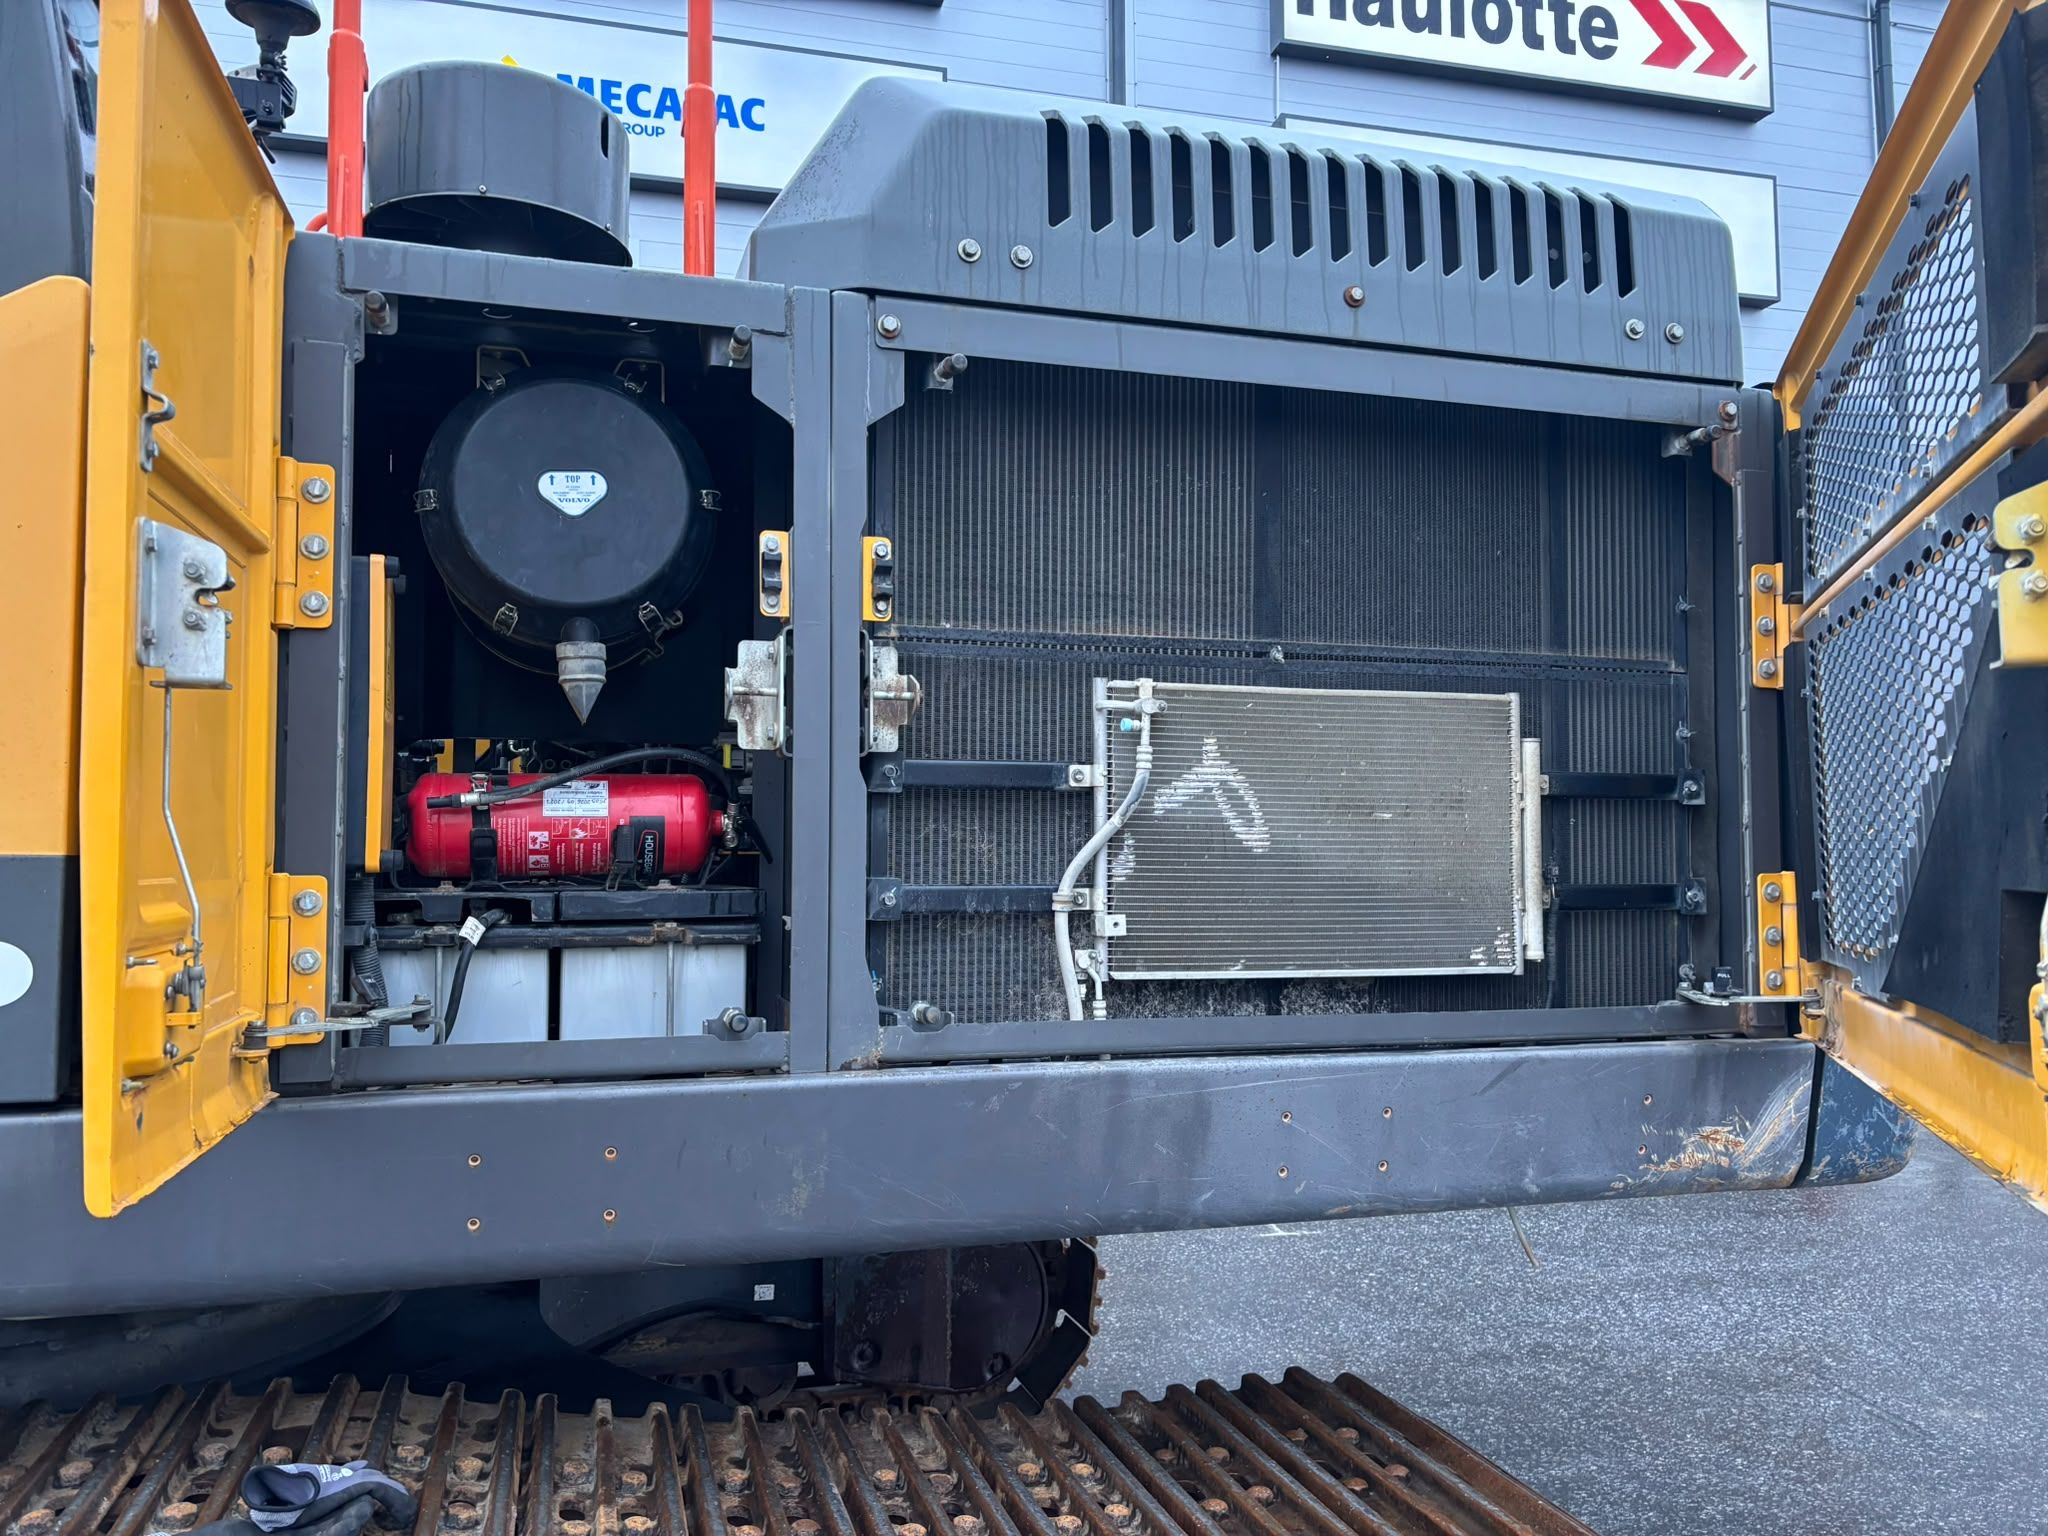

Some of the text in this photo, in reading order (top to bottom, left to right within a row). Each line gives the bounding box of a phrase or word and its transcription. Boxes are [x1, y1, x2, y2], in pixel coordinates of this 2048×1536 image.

[1296, 0, 1619, 61] aulotte
[556, 73, 765, 132] ECAAC
[622, 122, 665, 137] ROUP
[565, 475, 580, 483] TOP
